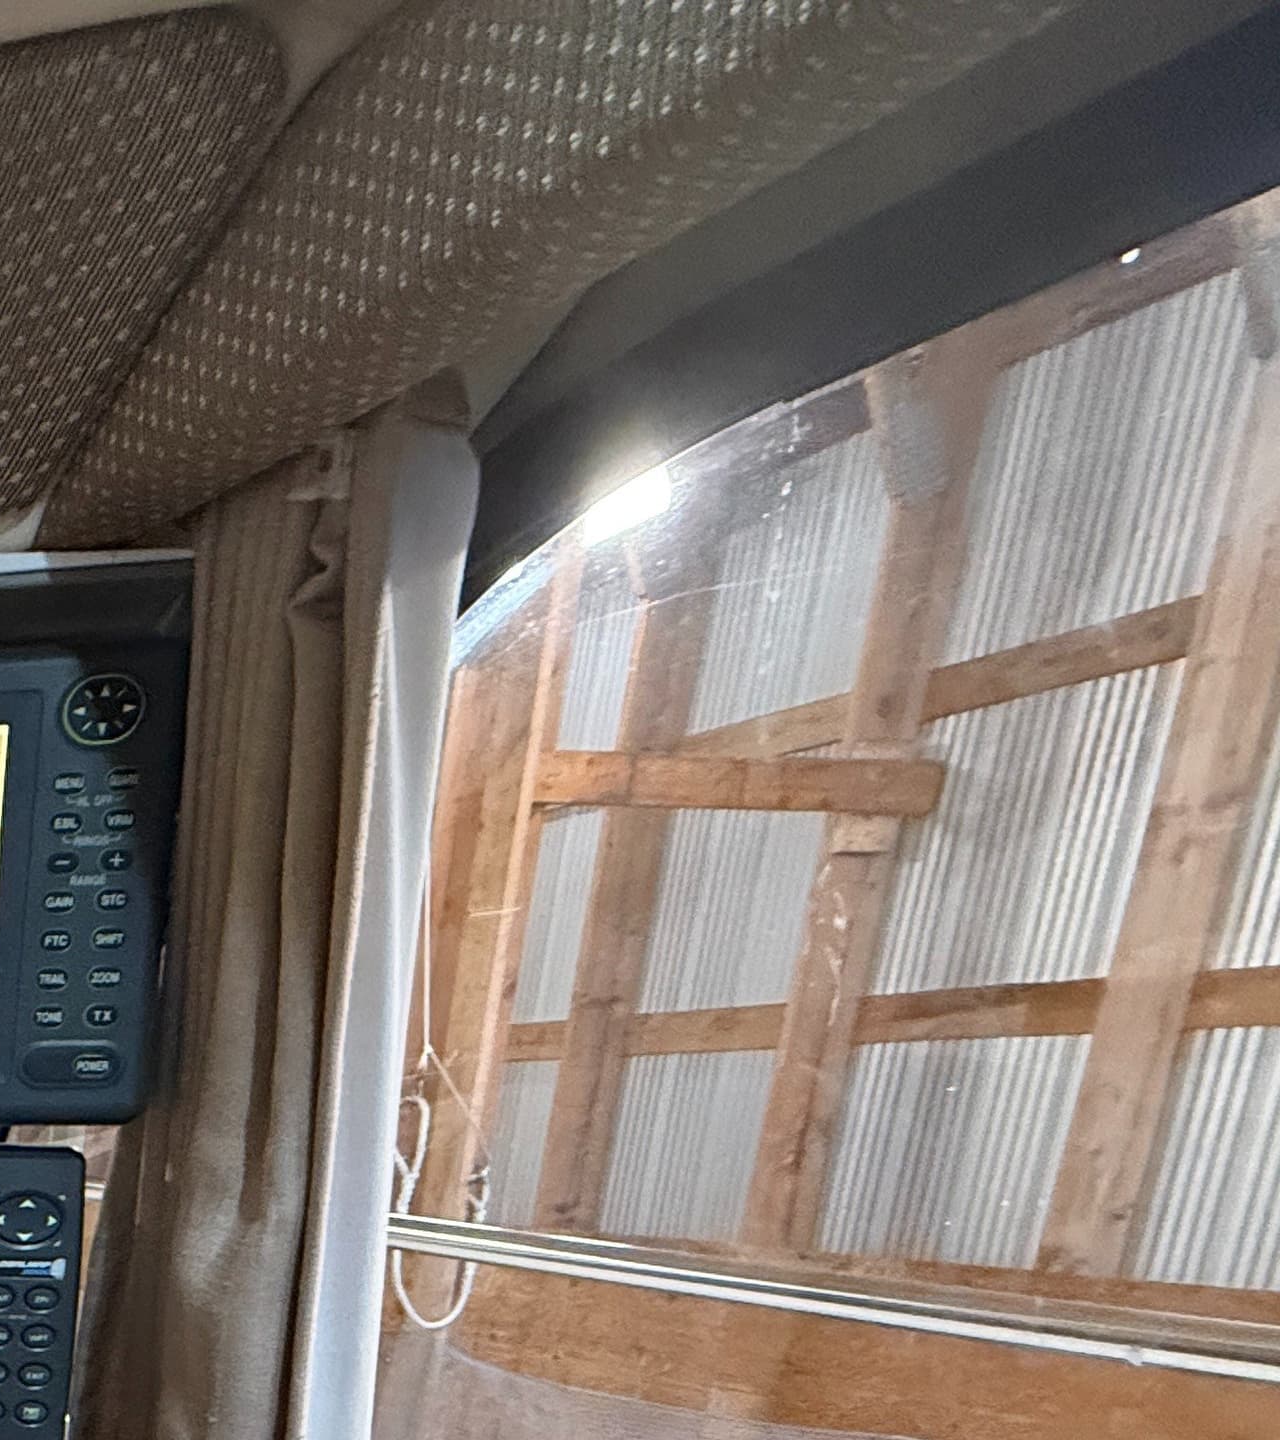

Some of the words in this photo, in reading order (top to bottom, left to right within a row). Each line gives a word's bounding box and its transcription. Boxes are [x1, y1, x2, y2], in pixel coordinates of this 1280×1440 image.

[44, 896, 75, 908] GAIN
[100, 893, 127, 907] STC
[43, 934, 70, 947] FTC
[39, 972, 67, 985] TRAIL
[90, 970, 121, 984] ZOOM
[93, 1009, 113, 1022] TX
[75, 1059, 110, 1073] POWER
